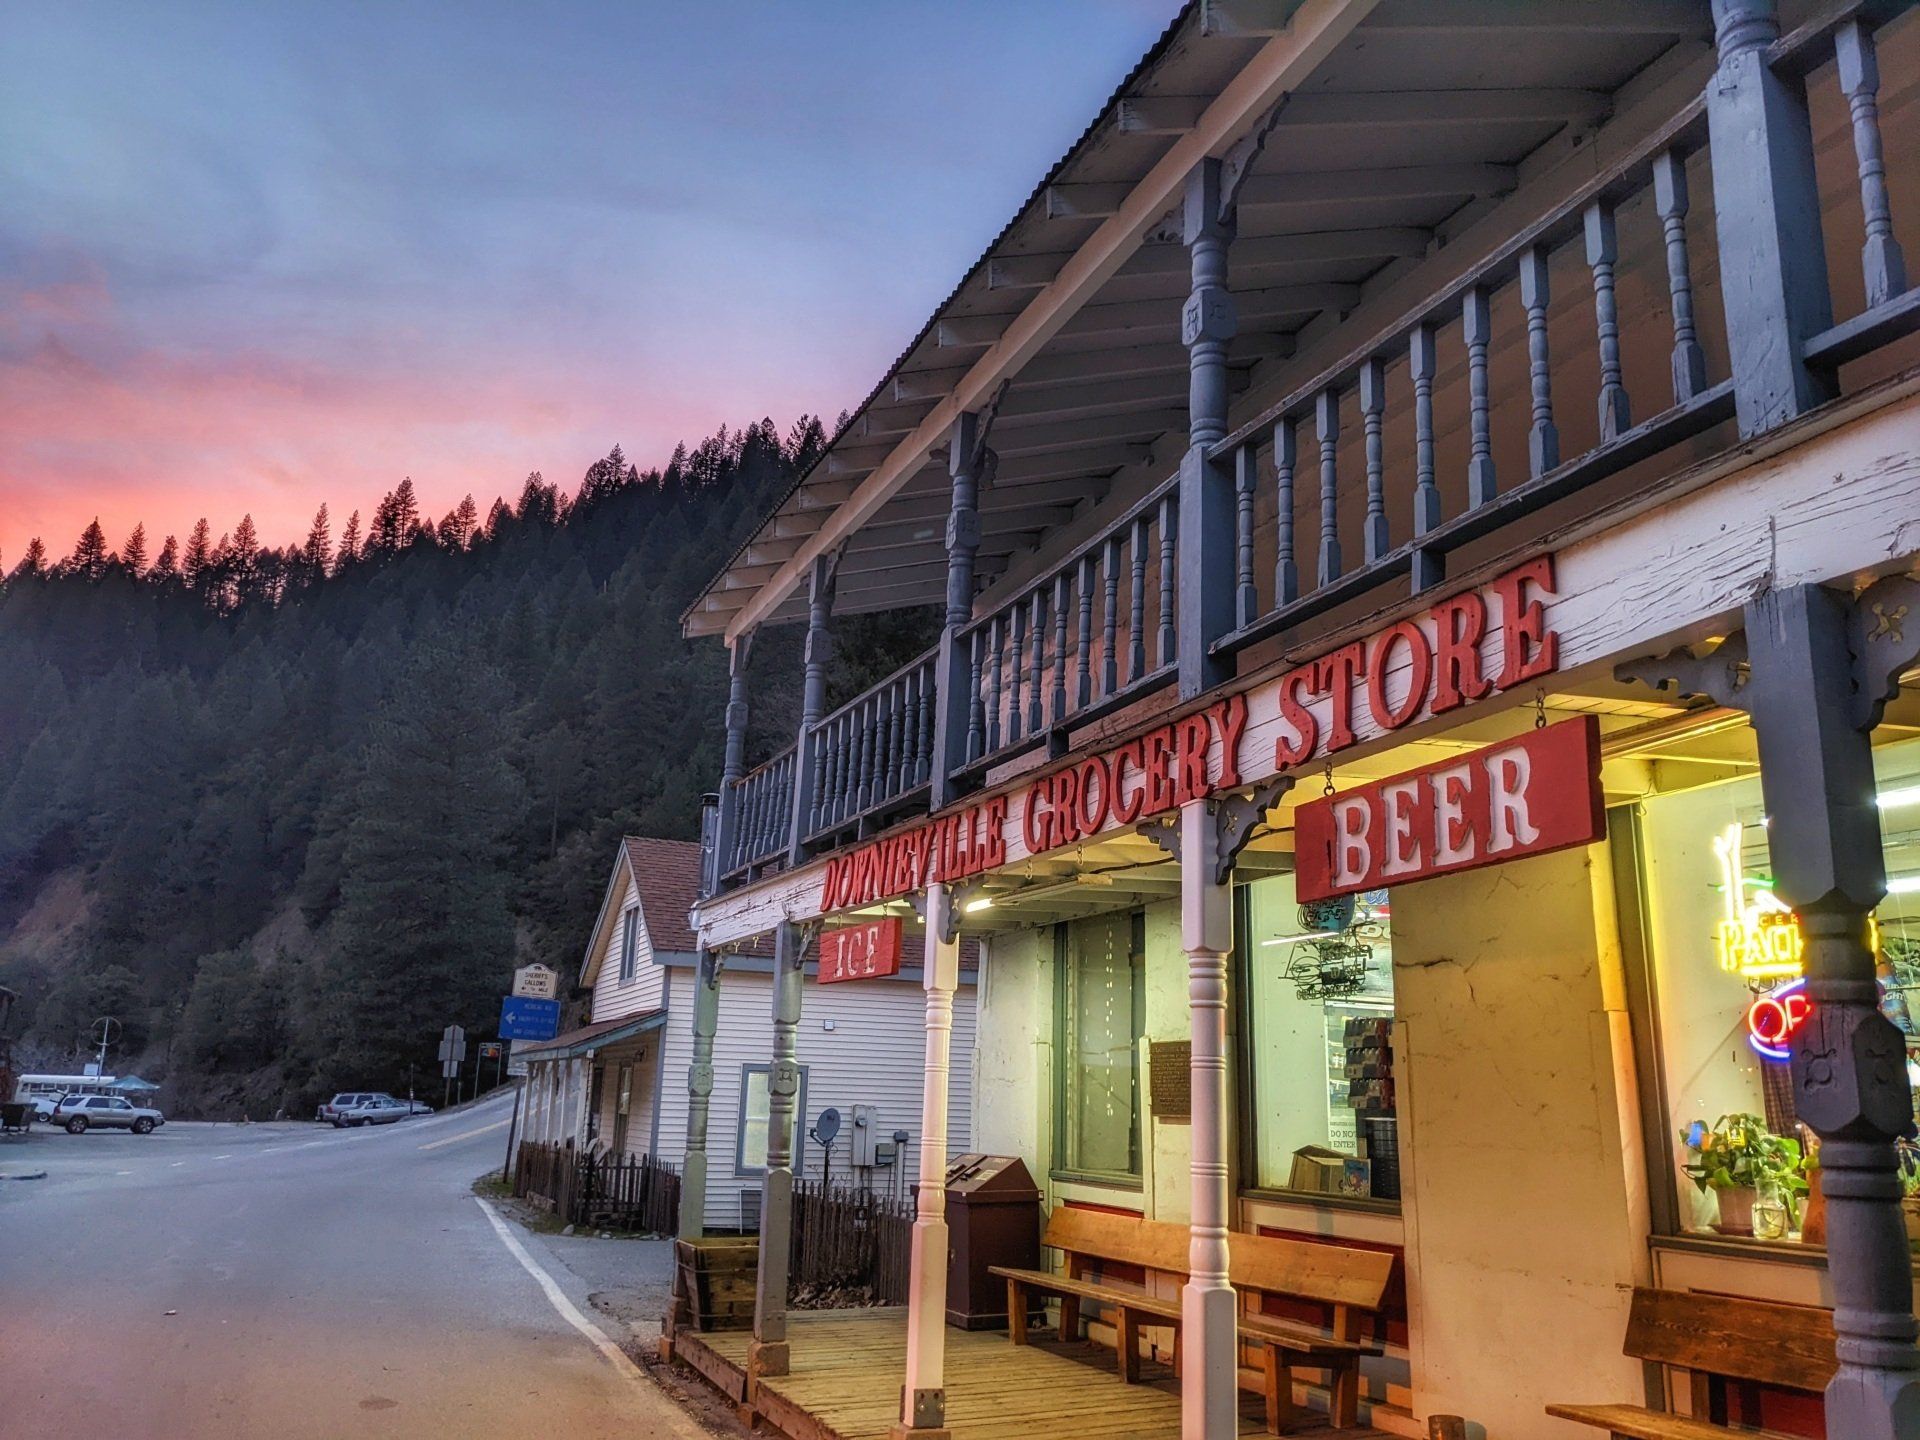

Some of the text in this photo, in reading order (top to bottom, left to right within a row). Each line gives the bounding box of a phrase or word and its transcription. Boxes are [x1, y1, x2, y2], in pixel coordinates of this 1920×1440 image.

[819, 552, 1559, 912] DOWNIEVILLE GROCERY STORE
[1330, 746, 1540, 888] BEER
[833, 927, 879, 977] ICE
[1749, 994, 1812, 1042] OP
[1330, 1130, 1341, 1138] DO
